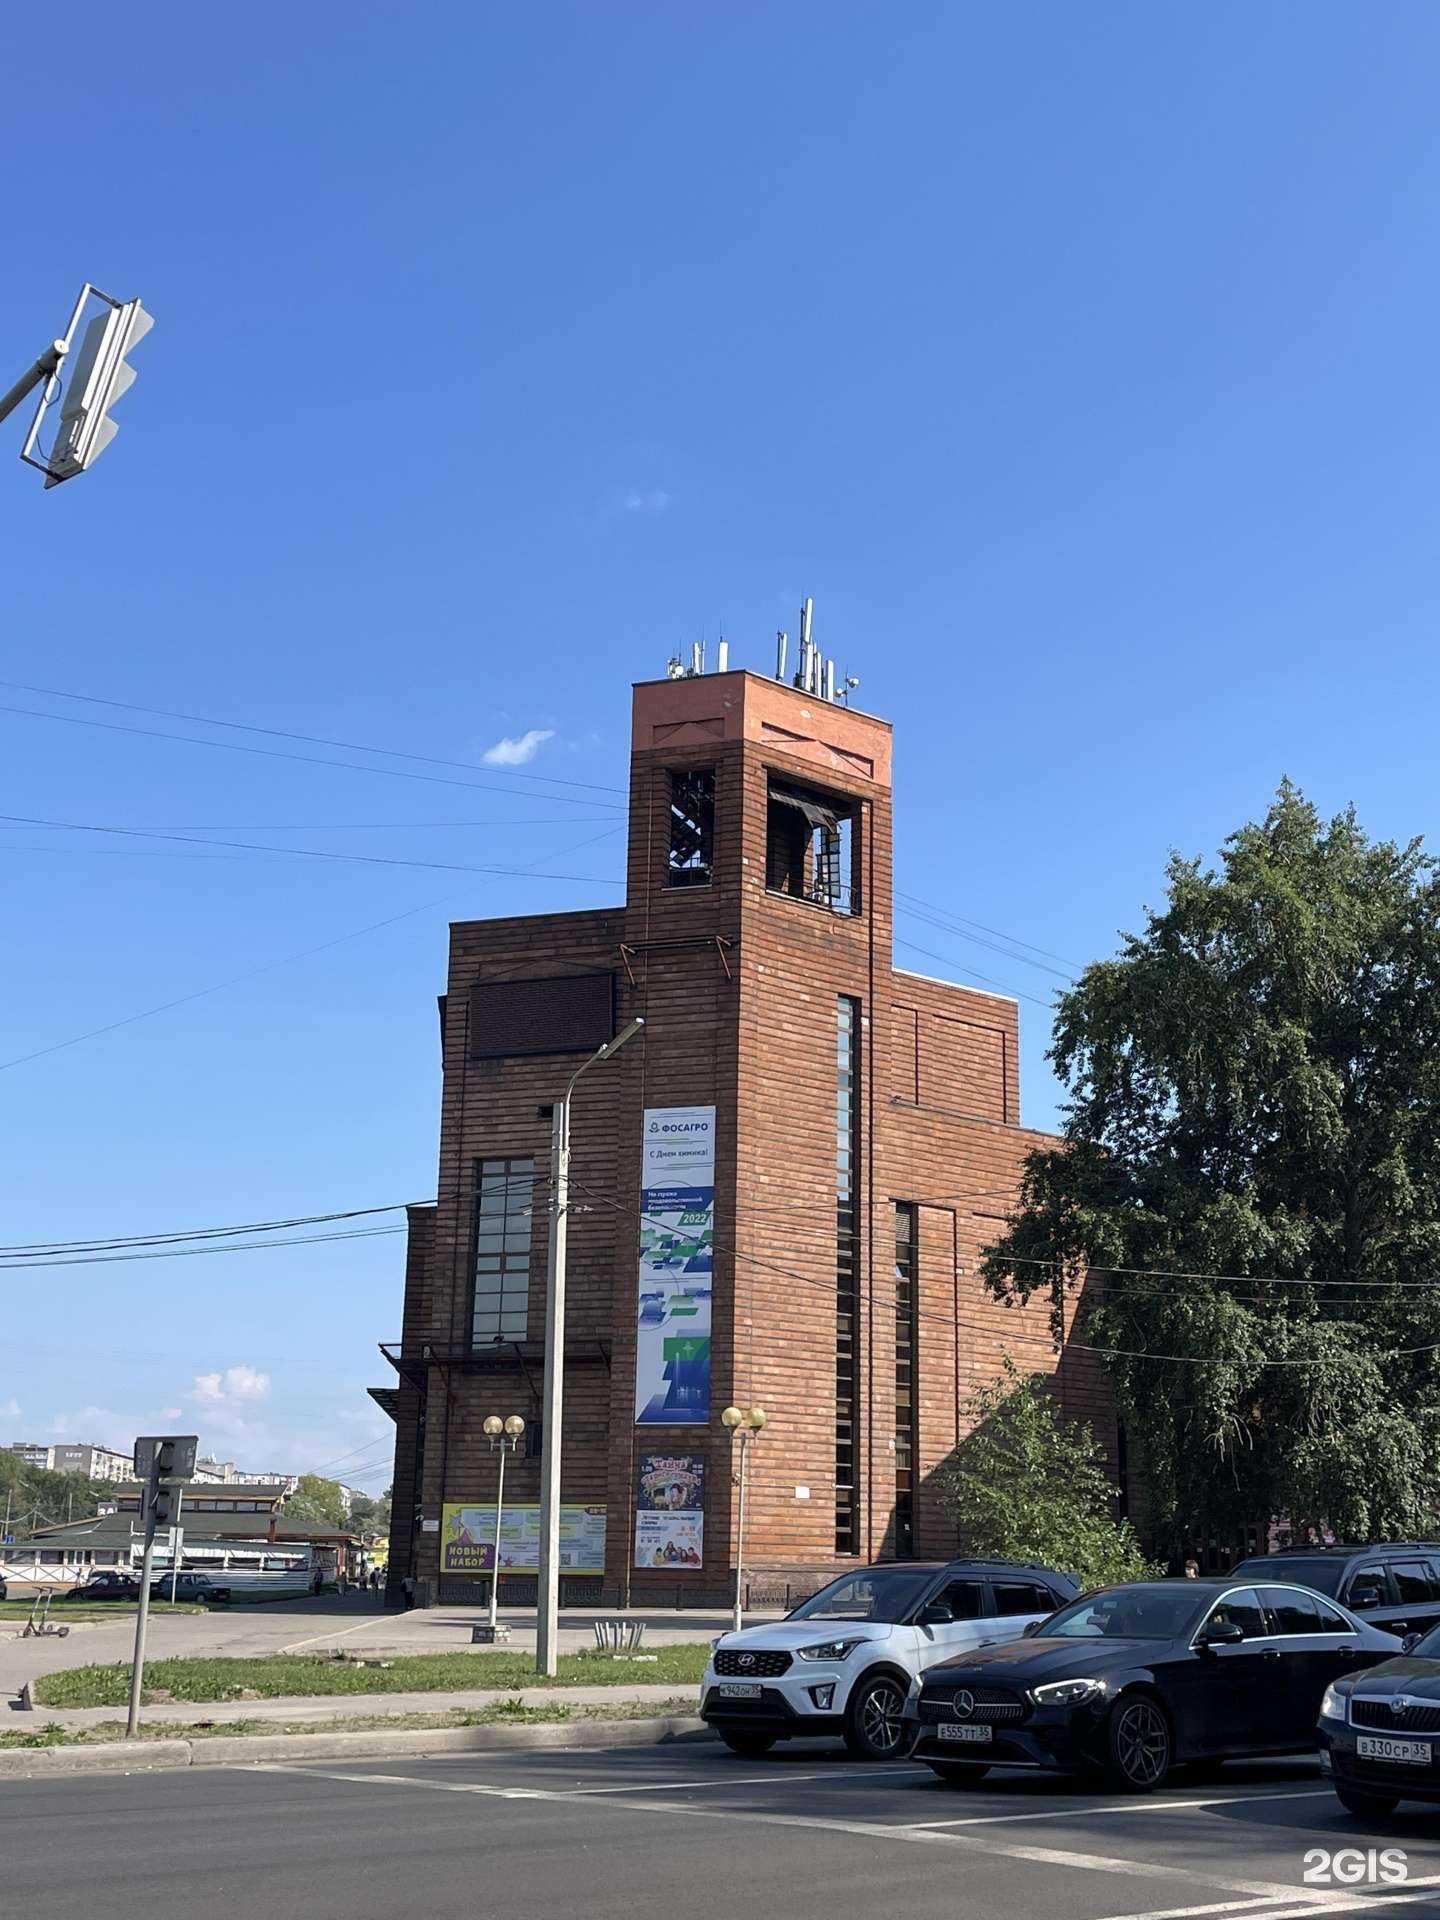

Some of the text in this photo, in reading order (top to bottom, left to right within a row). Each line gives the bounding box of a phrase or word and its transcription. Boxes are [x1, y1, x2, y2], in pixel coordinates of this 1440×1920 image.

[662, 1123, 708, 1132] ФОСАГРО
[656, 1150, 677, 1159] Днем
[678, 1148, 708, 1157] химика!
[683, 1214, 707, 1223] 2022
[448, 1545, 488, 1555] НОВЫЙ
[450, 1558, 485, 1567] НАБОР
[978, 1726, 990, 1737] 35
[1361, 1739, 1426, 1758] В330СР 35
